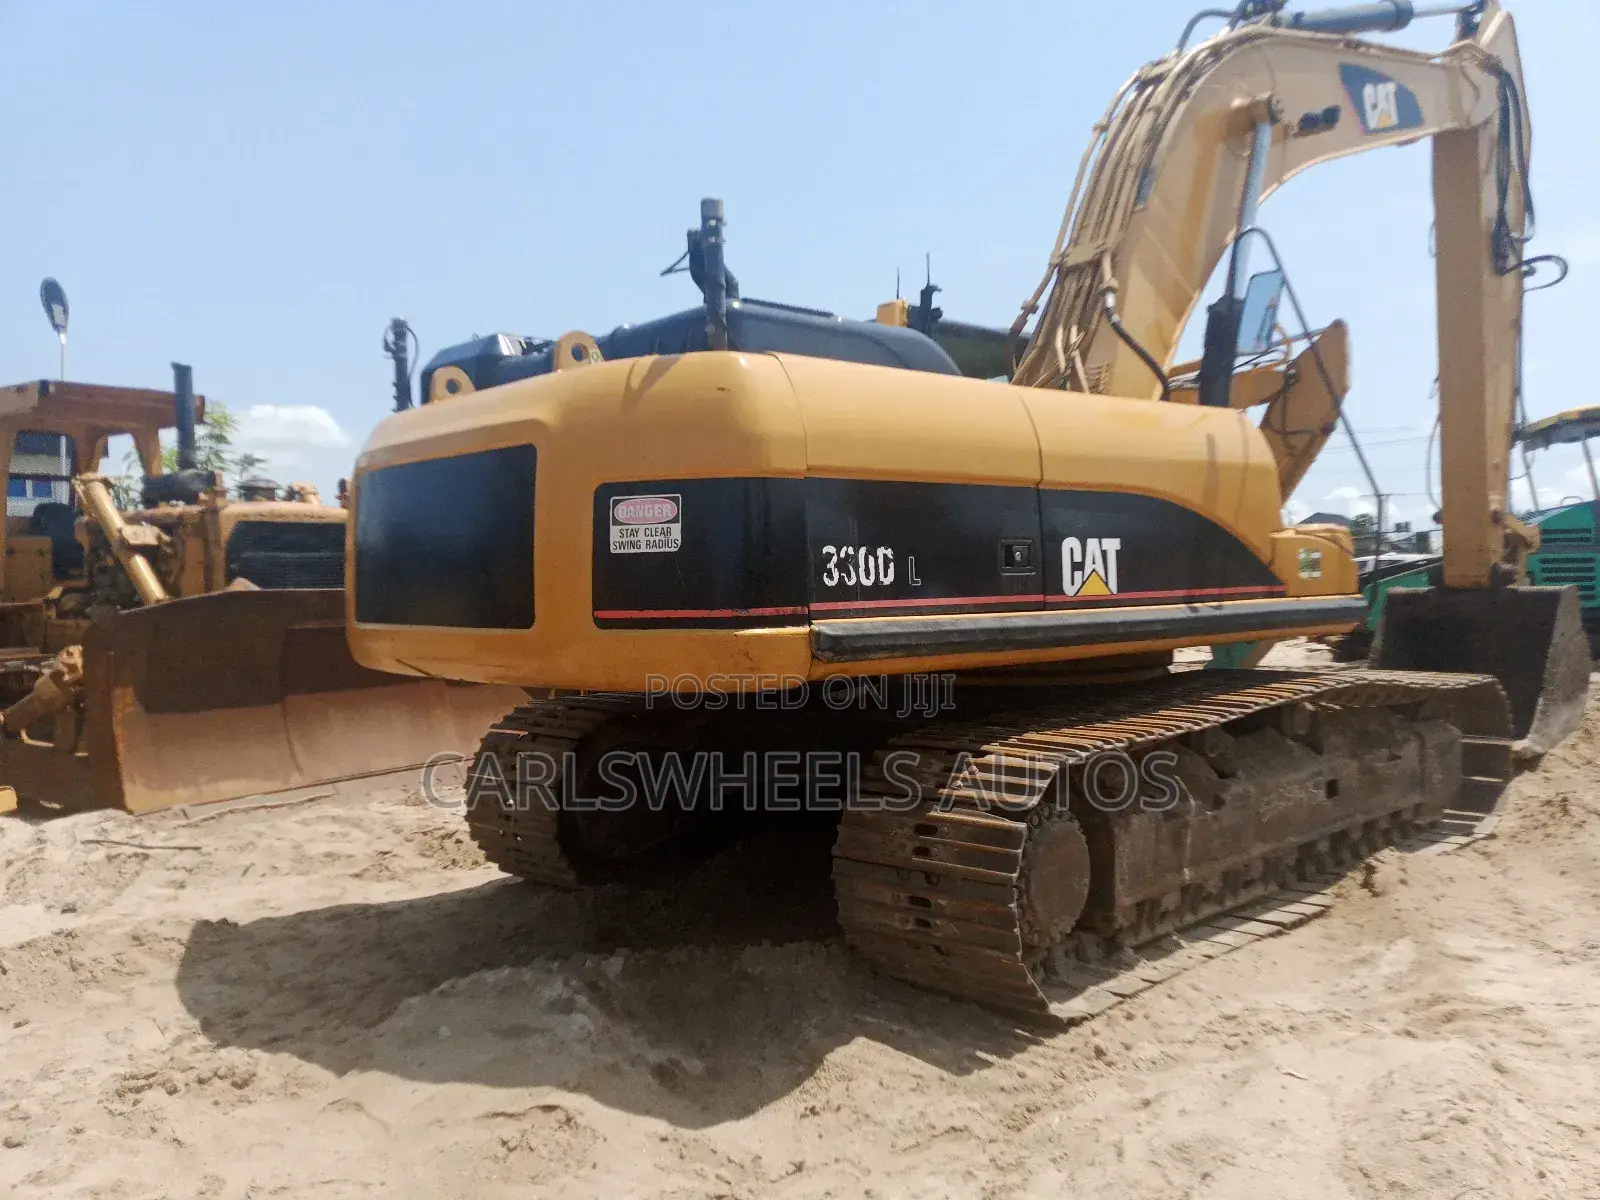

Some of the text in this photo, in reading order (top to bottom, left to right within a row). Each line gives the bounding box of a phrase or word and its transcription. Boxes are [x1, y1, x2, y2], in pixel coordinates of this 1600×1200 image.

[1362, 81, 1399, 130] CAT
[617, 502, 673, 519] DANGER
[619, 526, 672, 539] STAY CLEAR
[612, 538, 679, 551] SWING RADIUS
[908, 556, 922, 586] L
[1061, 536, 1122, 597] CAT
